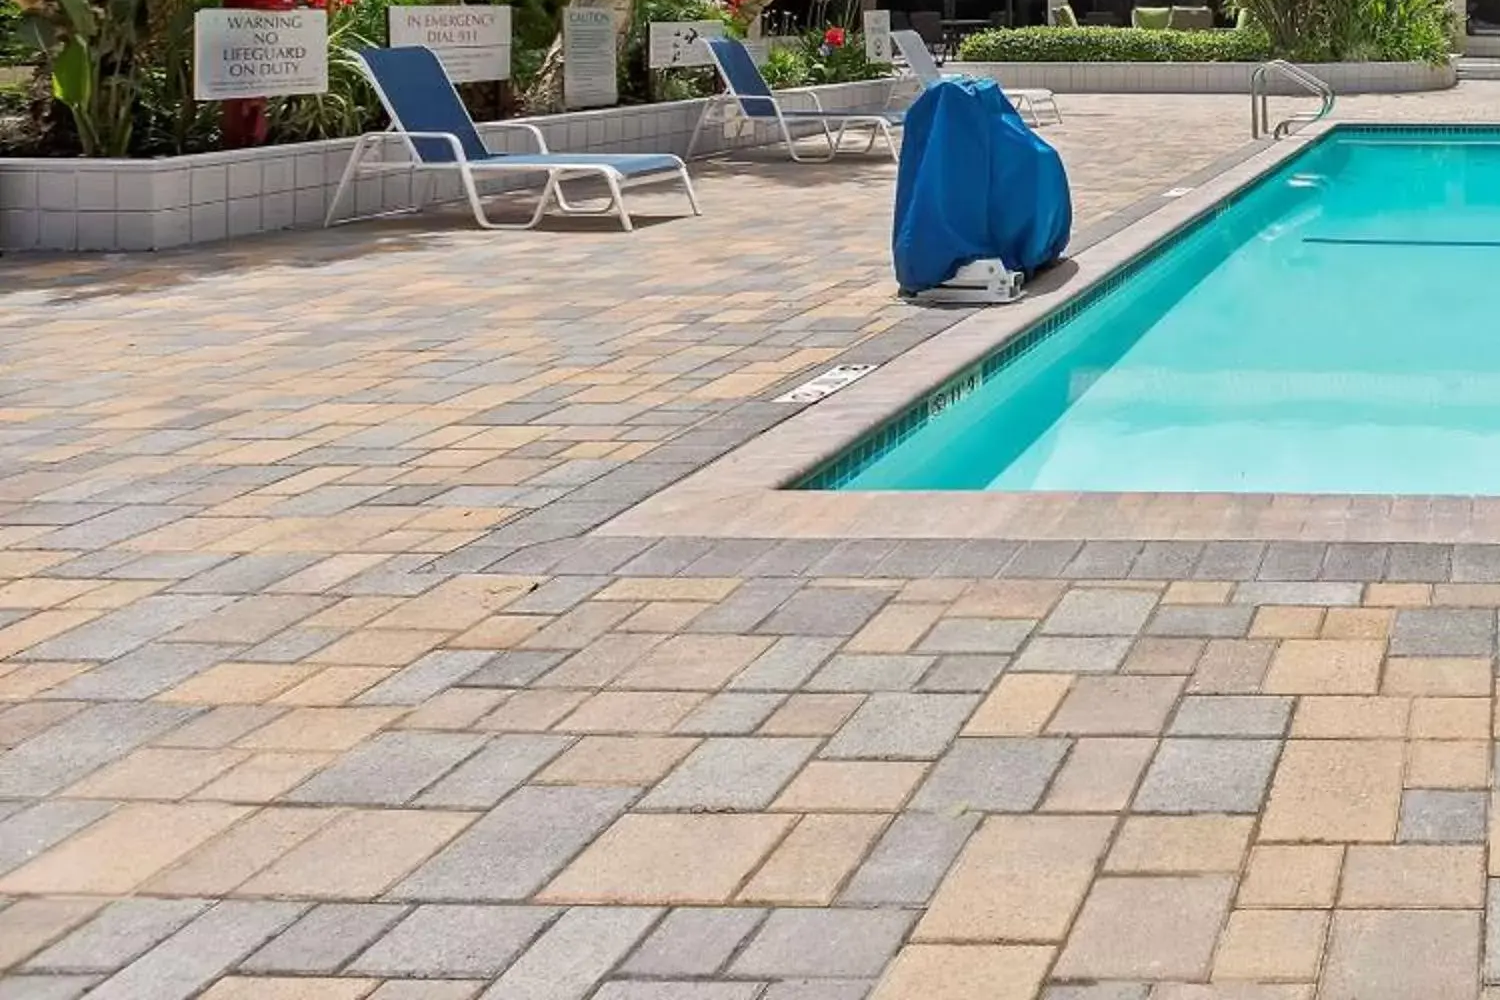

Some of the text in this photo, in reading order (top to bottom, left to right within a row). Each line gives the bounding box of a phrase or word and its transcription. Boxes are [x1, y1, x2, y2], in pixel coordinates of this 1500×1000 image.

[227, 15, 302, 30] WARNING
[407, 13, 494, 28] IN EMERGENCY
[254, 31, 278, 45] NO
[428, 29, 478, 43] DIAL 911
[223, 47, 307, 60] LIFEGUARD
[229, 61, 299, 77] ON DUTY
